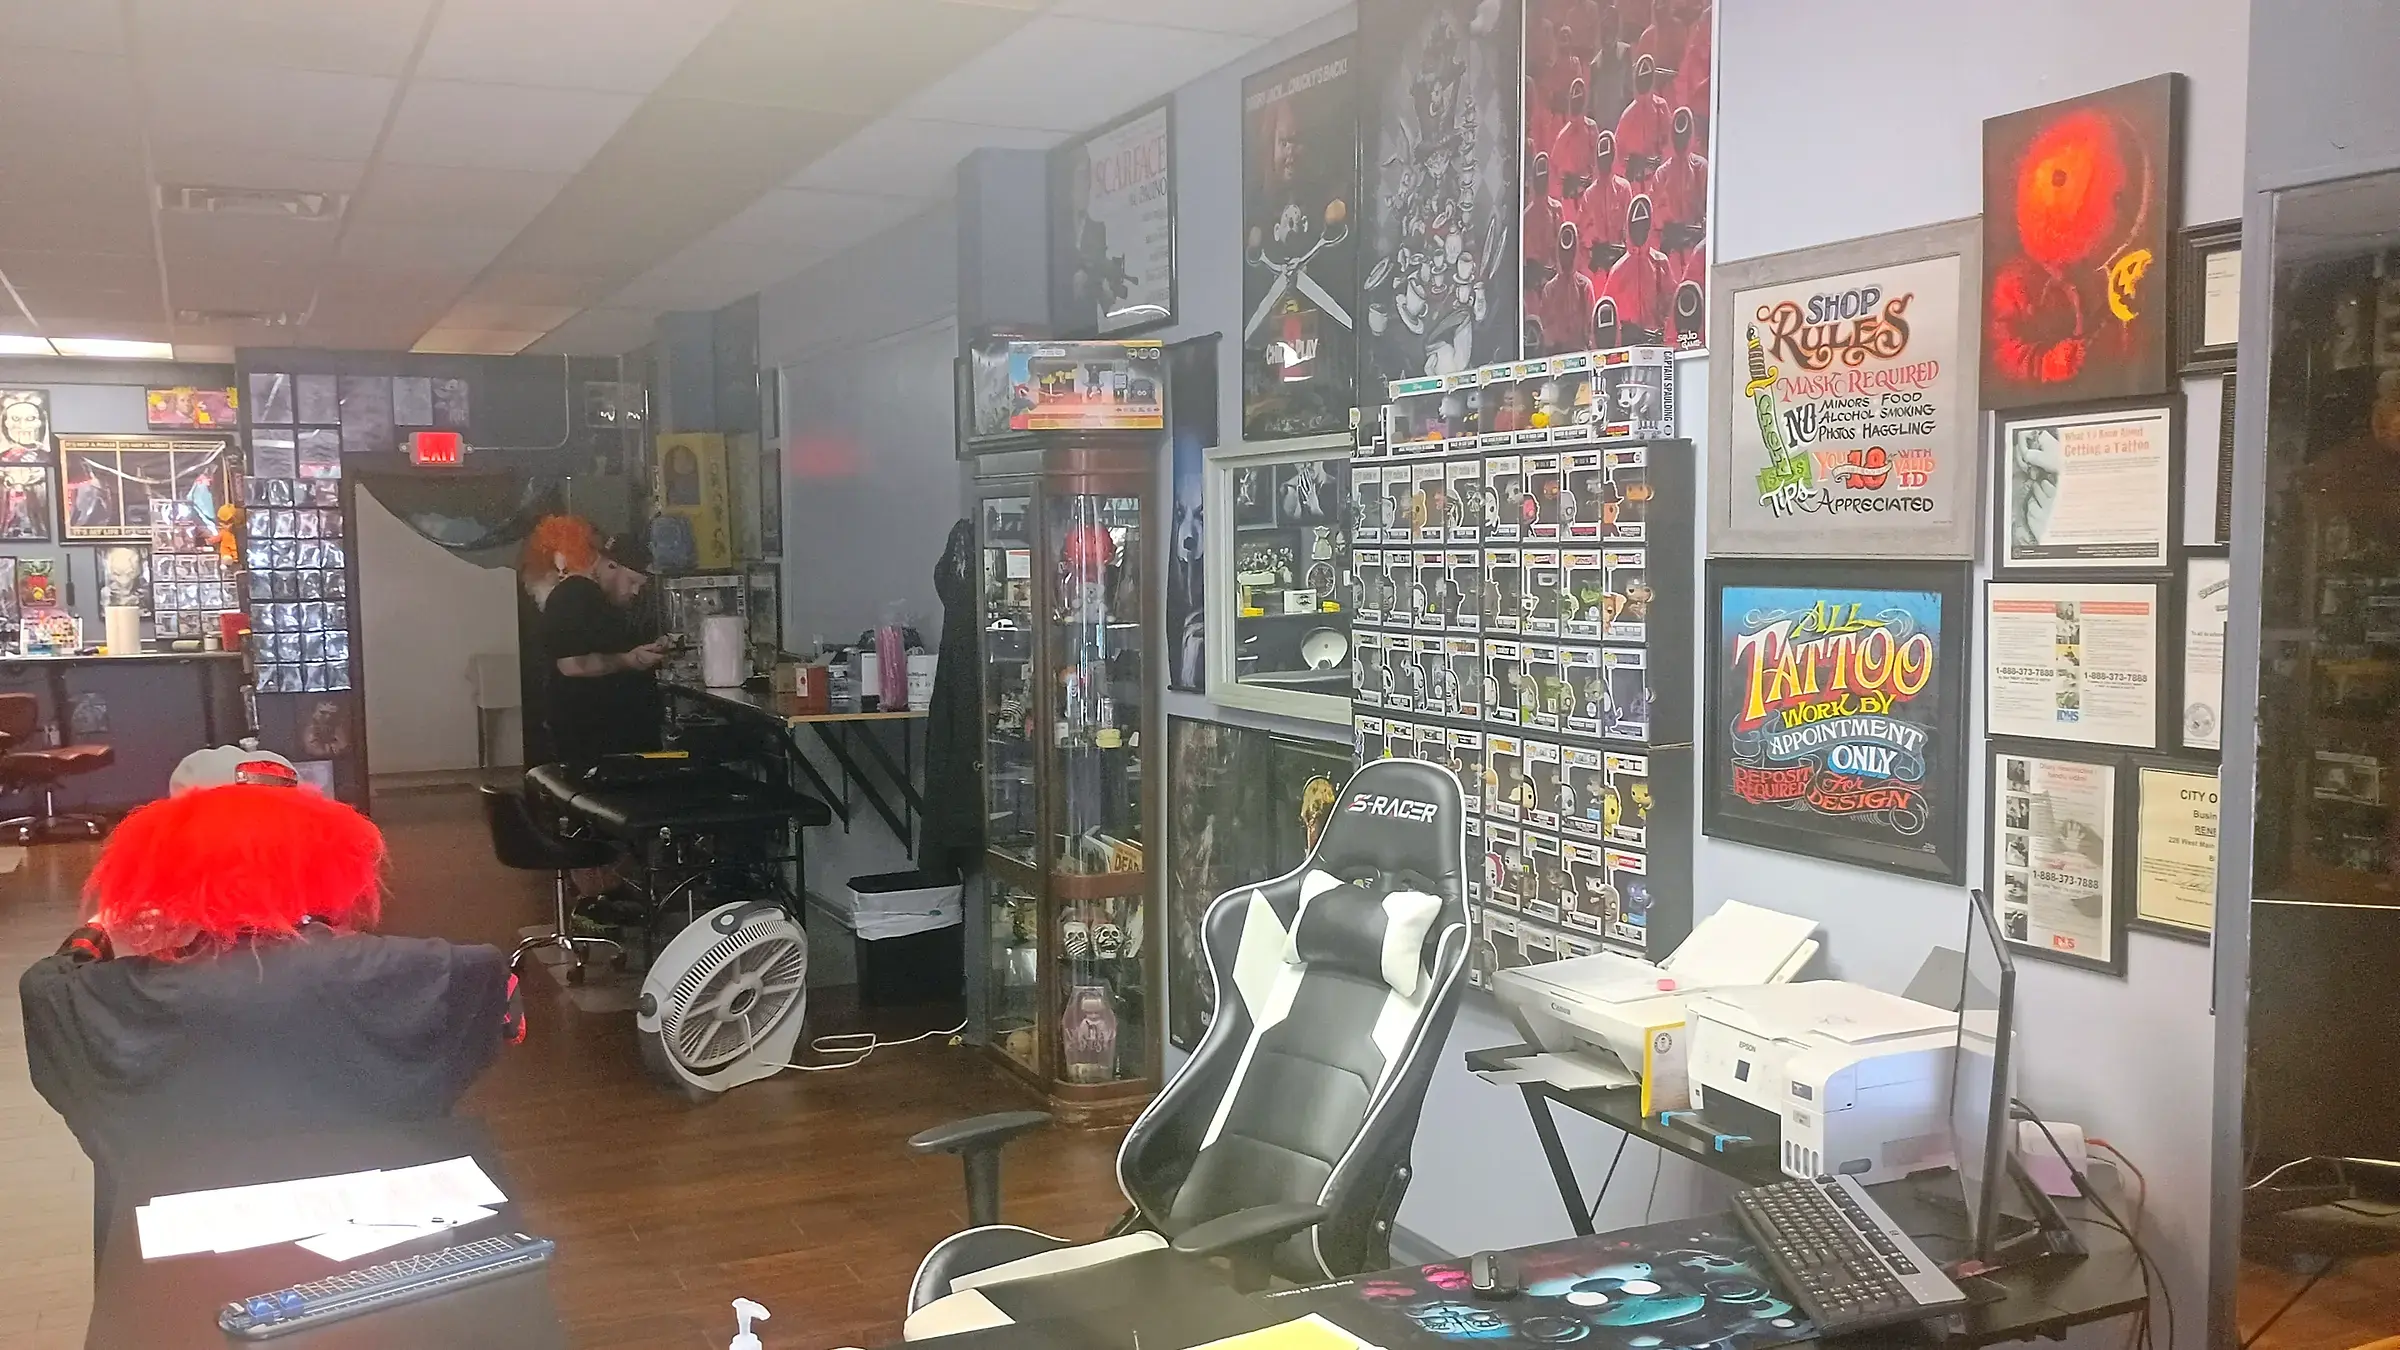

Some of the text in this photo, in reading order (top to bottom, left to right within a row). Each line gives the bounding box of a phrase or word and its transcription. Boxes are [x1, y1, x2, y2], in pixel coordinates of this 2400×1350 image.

[1095, 134, 1167, 199] SCARFACE
[1806, 287, 1881, 325] SHOP
[1756, 292, 1914, 371] RULES
[1296, 338, 1318, 359] PLAY
[1663, 351, 1673, 421] CAPTAIN SPAULDING
[1777, 360, 1940, 402] MASK REQUIRED
[1819, 392, 1922, 413] MINORS FOOD
[1818, 404, 1936, 425] ALCOHOL SMOKING
[1784, 402, 1818, 449] NO
[1818, 420, 1937, 442] PHOTOS HAGGLING
[1897, 448, 1932, 459] WITH
[2064, 439, 2150, 457] Getting a Tattoo
[1893, 457, 1935, 478] VALID
[1898, 471, 1929, 488] ID
[1758, 479, 1935, 518] TIPS APPRECIATED
[1790, 600, 1887, 639] ALL
[1734, 619, 1934, 724] TATTOO
[1996, 666, 2054, 678] 1-888-373-7888
[2084, 671, 2148, 683] 1-888-373-7888
[1782, 690, 1897, 729] WORK BY
[1770, 718, 1924, 756] APPOINTMENT
[1829, 744, 1899, 776] ONLY
[1735, 768, 1811, 784] DEPOSIT
[1734, 781, 1809, 804] REQUIRED
[1807, 790, 1912, 811] DESIGN
[2180, 789, 2205, 804] CITY
[1348, 793, 1439, 824] S-RACER
[2181, 838, 2198, 848] West
[2033, 869, 2099, 890] 1-888-373-7888
[1551, 1002, 1571, 1016] Canon
[1739, 1041, 1757, 1053] EPSON
